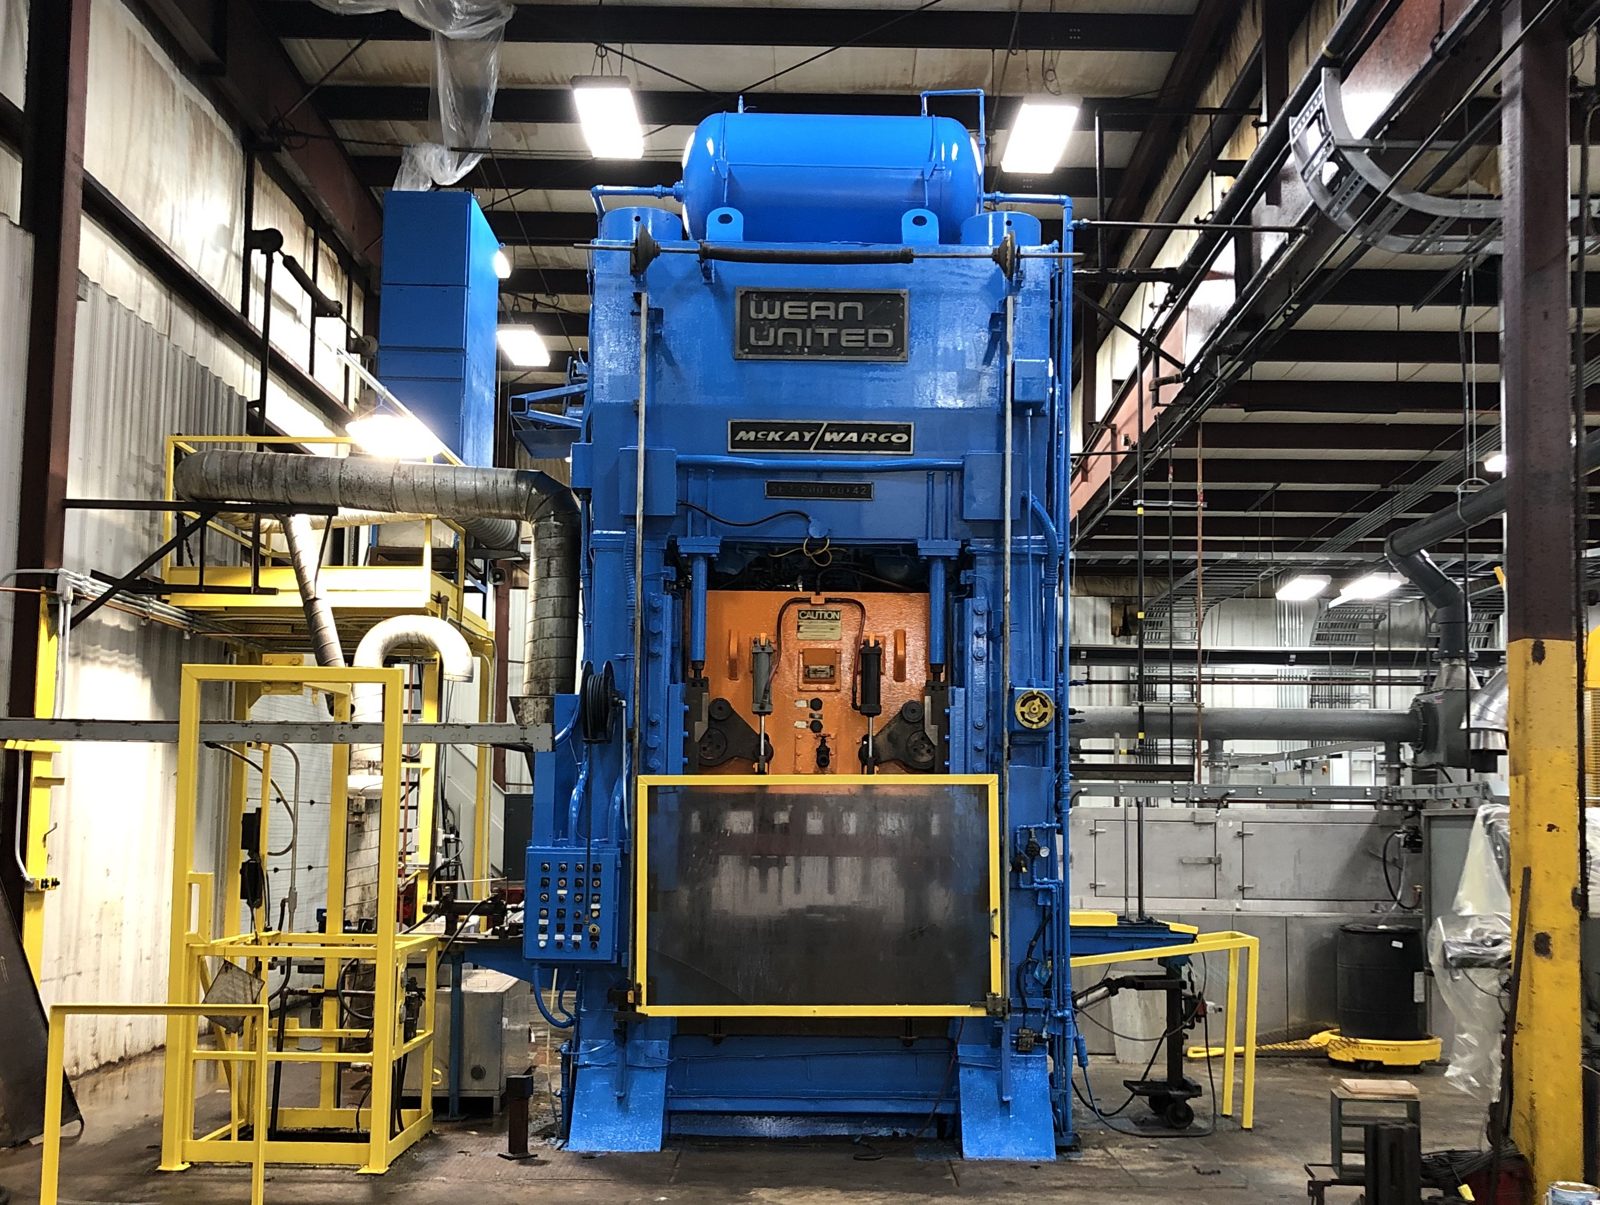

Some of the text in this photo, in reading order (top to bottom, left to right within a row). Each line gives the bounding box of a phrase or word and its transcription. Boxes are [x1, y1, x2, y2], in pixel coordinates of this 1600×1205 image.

[750, 300, 864, 321] WEAN
[750, 327, 894, 348] UNITED
[799, 610, 840, 620] CAUTION
